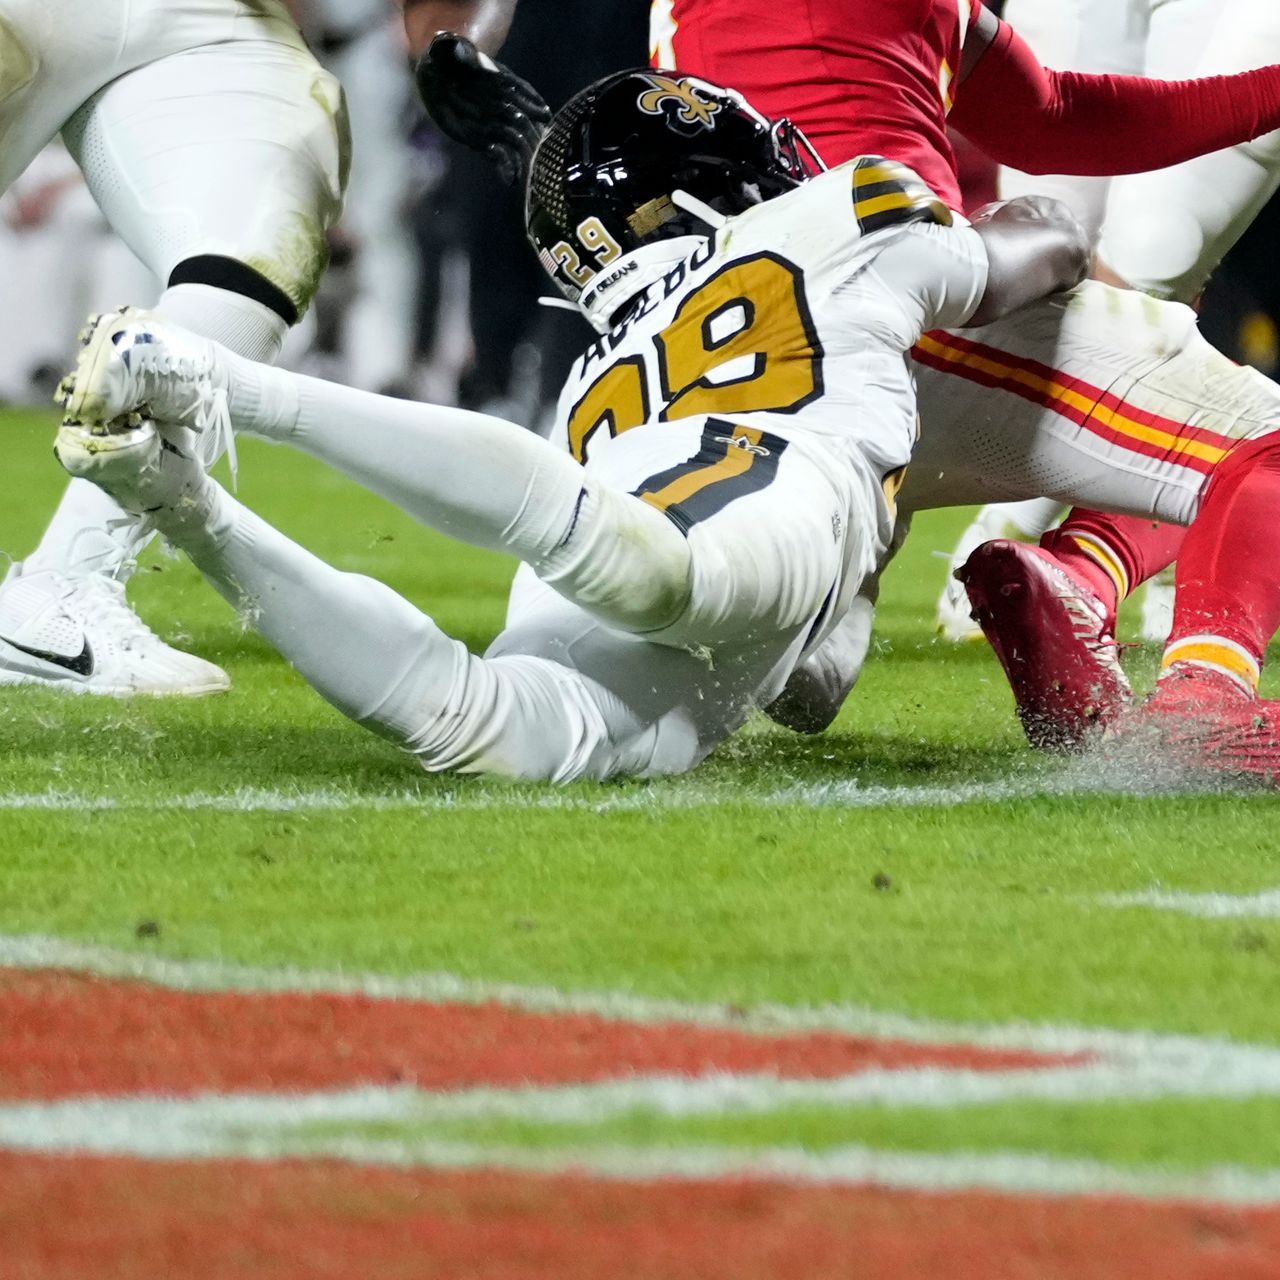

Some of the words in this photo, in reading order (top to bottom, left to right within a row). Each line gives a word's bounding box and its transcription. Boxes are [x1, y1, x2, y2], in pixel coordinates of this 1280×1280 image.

[549, 216, 622, 289] 29
[595, 260, 639, 293] ORLEANS
[567, 249, 825, 468] 29
